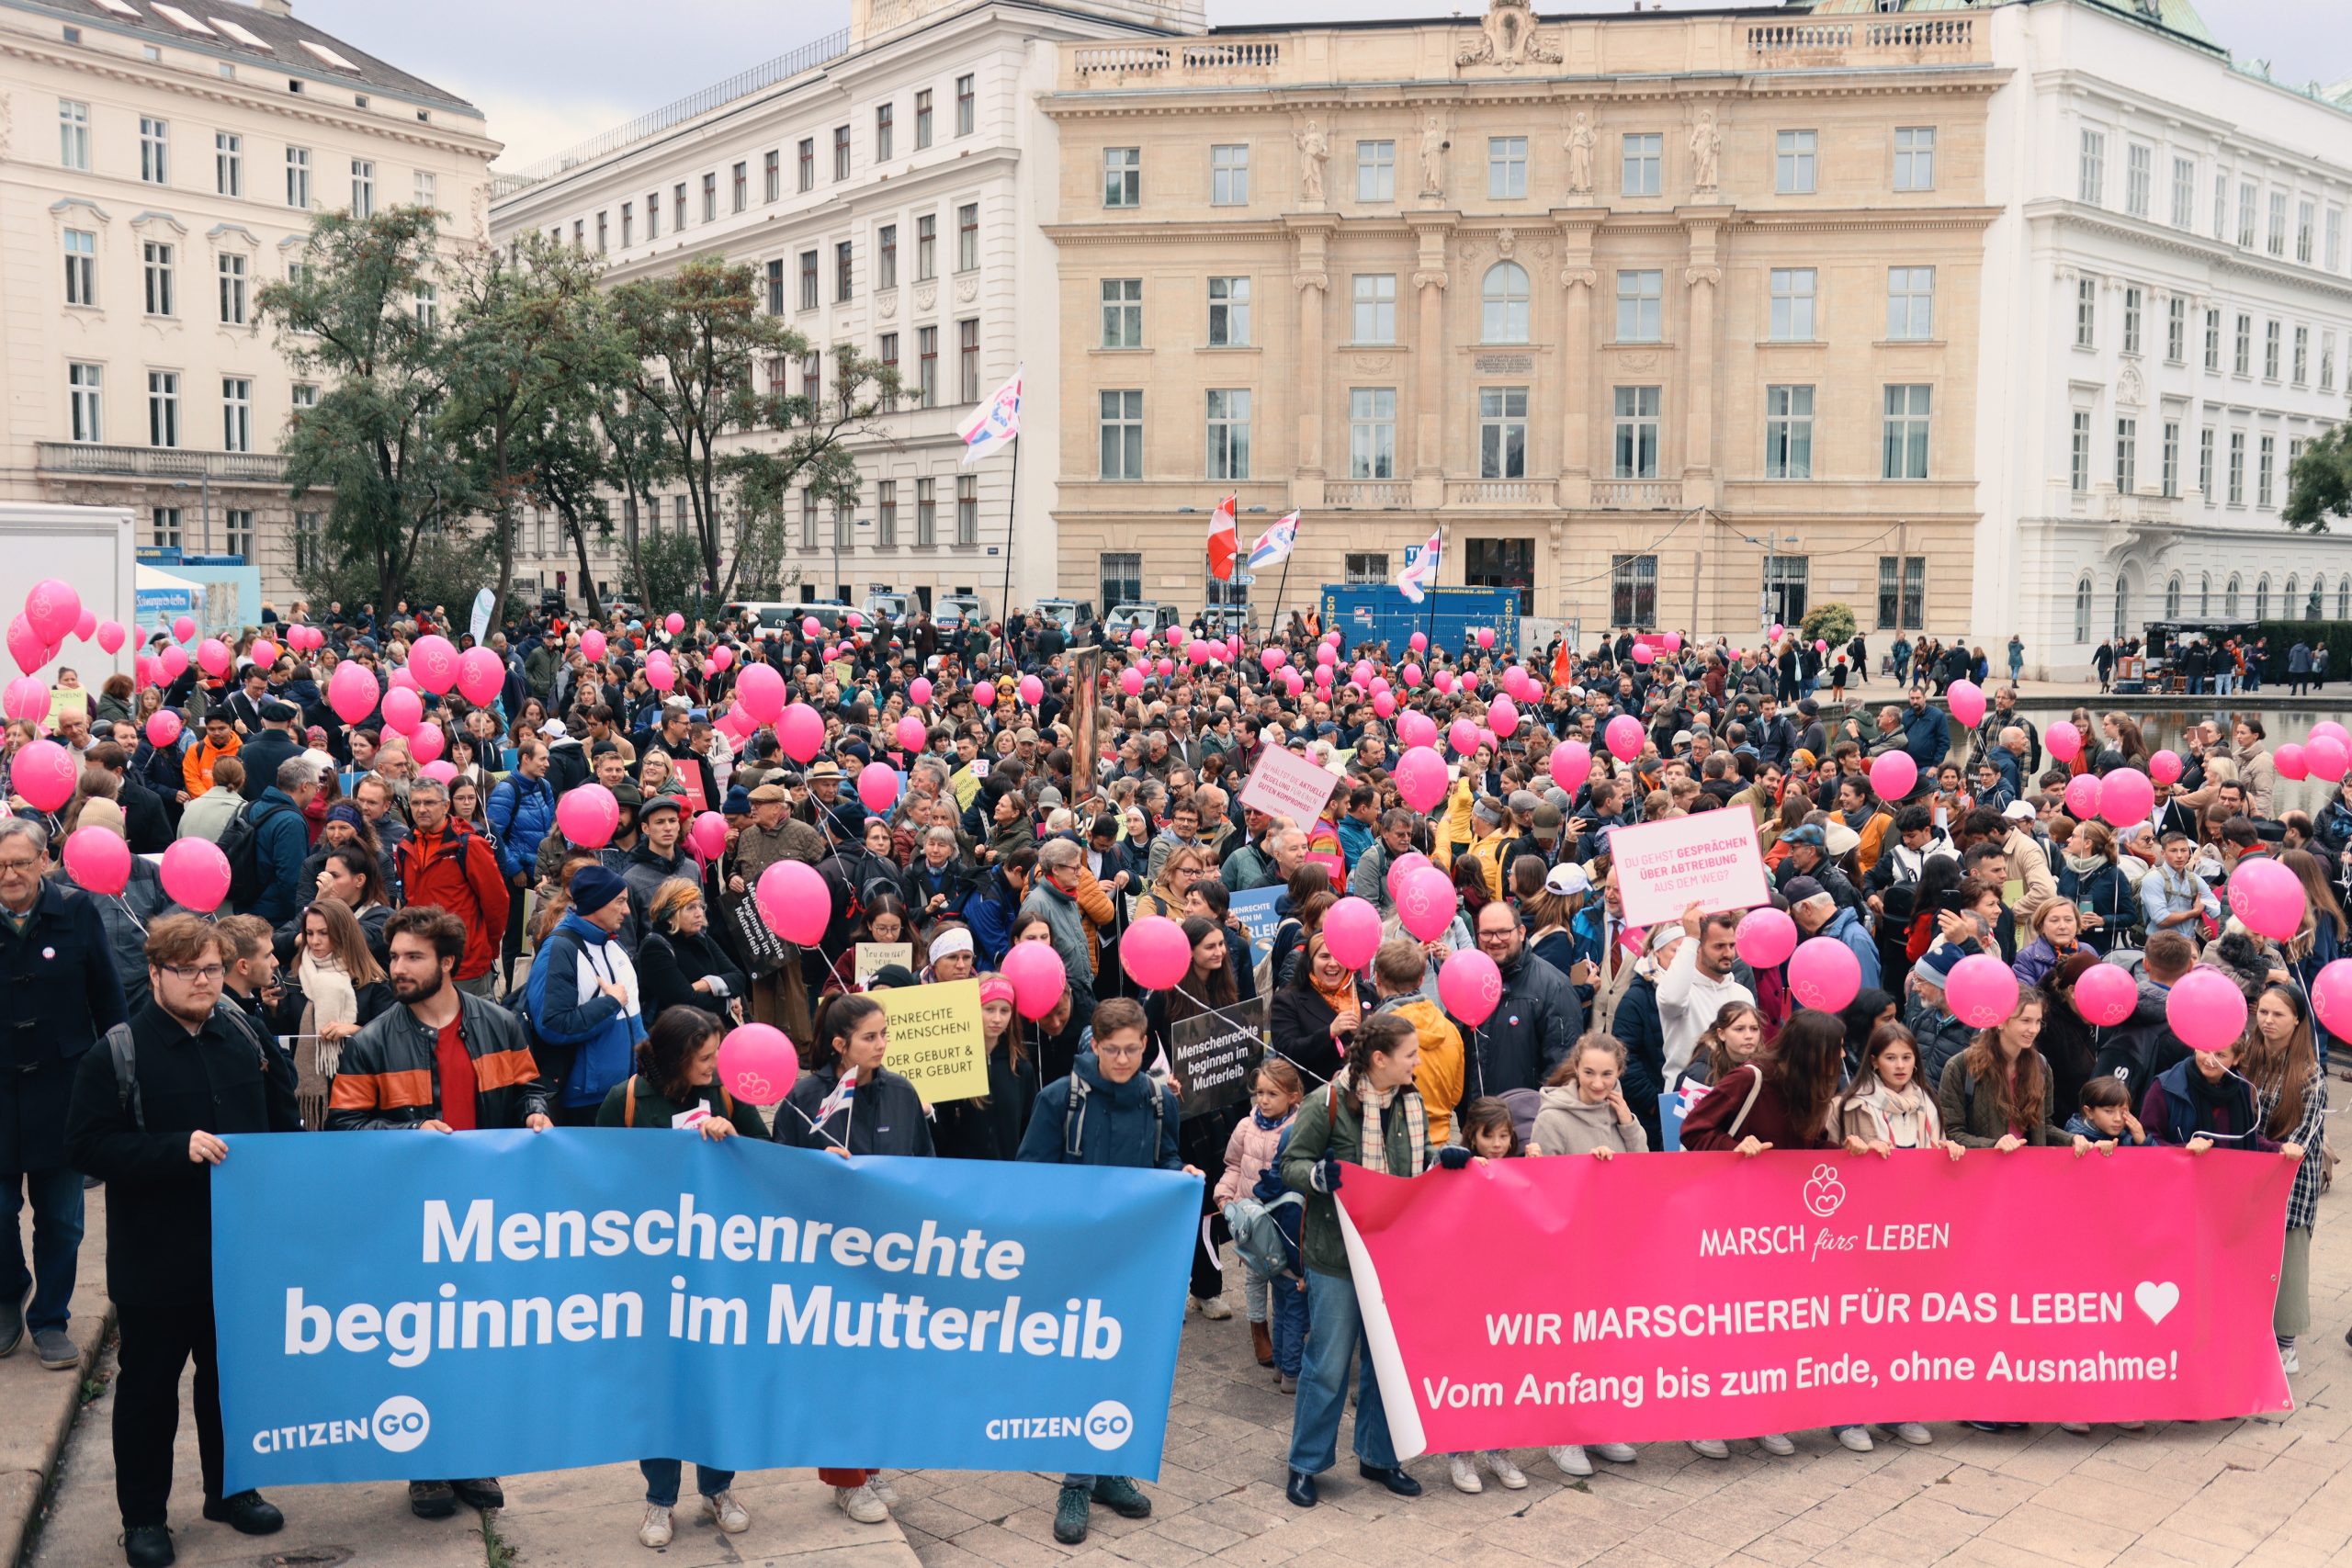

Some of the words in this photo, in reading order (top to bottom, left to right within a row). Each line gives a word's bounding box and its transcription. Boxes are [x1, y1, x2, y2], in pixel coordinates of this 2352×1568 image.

[1258, 782, 1276, 795] GUTEN
[1261, 773, 1291, 791] REGELUNG
[1299, 779, 1327, 799] AKTUELLE
[1624, 856, 1639, 868] DU
[1641, 850, 1674, 865] GEHST
[1677, 836, 1747, 859] GESPRÄCHEN
[1640, 865, 1668, 880] ÜBER
[1671, 853, 1737, 875] ABTREIBUNG
[1654, 879, 1674, 893] AUS
[1678, 876, 1698, 888] DEM
[1700, 870, 1729, 884] WEG?
[735, 906, 761, 955] Mutterleib
[741, 896, 765, 942] beginnen
[761, 941, 771, 955] im
[896, 1021, 970, 1041] MENSCHEN!
[1177, 1025, 1259, 1061] Menschenrechte
[887, 1054, 910, 1066] DER
[914, 1047, 960, 1063] GEBURT
[965, 1045, 973, 1055] &
[899, 1069, 922, 1080] DER
[926, 1061, 972, 1077] GEBURT
[1188, 1051, 1234, 1076] beginnen
[1236, 1046, 1249, 1060] im
[1193, 1063, 1244, 1091] Mutterleib
[423, 1193, 1025, 1280] Menschenrechte
[1700, 1224, 1805, 1257] MARSCH
[1810, 1228, 1858, 1262] fürs
[1866, 1223, 1950, 1250] LEBEN
[285, 1282, 643, 1368] beginnen
[669, 1276, 748, 1345] im
[766, 1282, 1122, 1360] Mutterleib
[1486, 1314, 1562, 1346] WIR
[1573, 1295, 1829, 1343] MARSCHIEREN
[1840, 1288, 1911, 1325] FÜR
[1921, 1292, 1997, 1323] DAS
[2010, 1292, 2122, 1324] LEBEN
[1421, 1376, 1503, 1409] Vom
[1514, 1371, 1644, 1408] Anfang
[1657, 1367, 1711, 1398] bis
[1721, 1368, 1787, 1396] zum
[1796, 1353, 1879, 1389] Ende,
[1890, 1350, 1975, 1382] ohne
[1986, 1350, 2177, 1382] Ausnahme!
